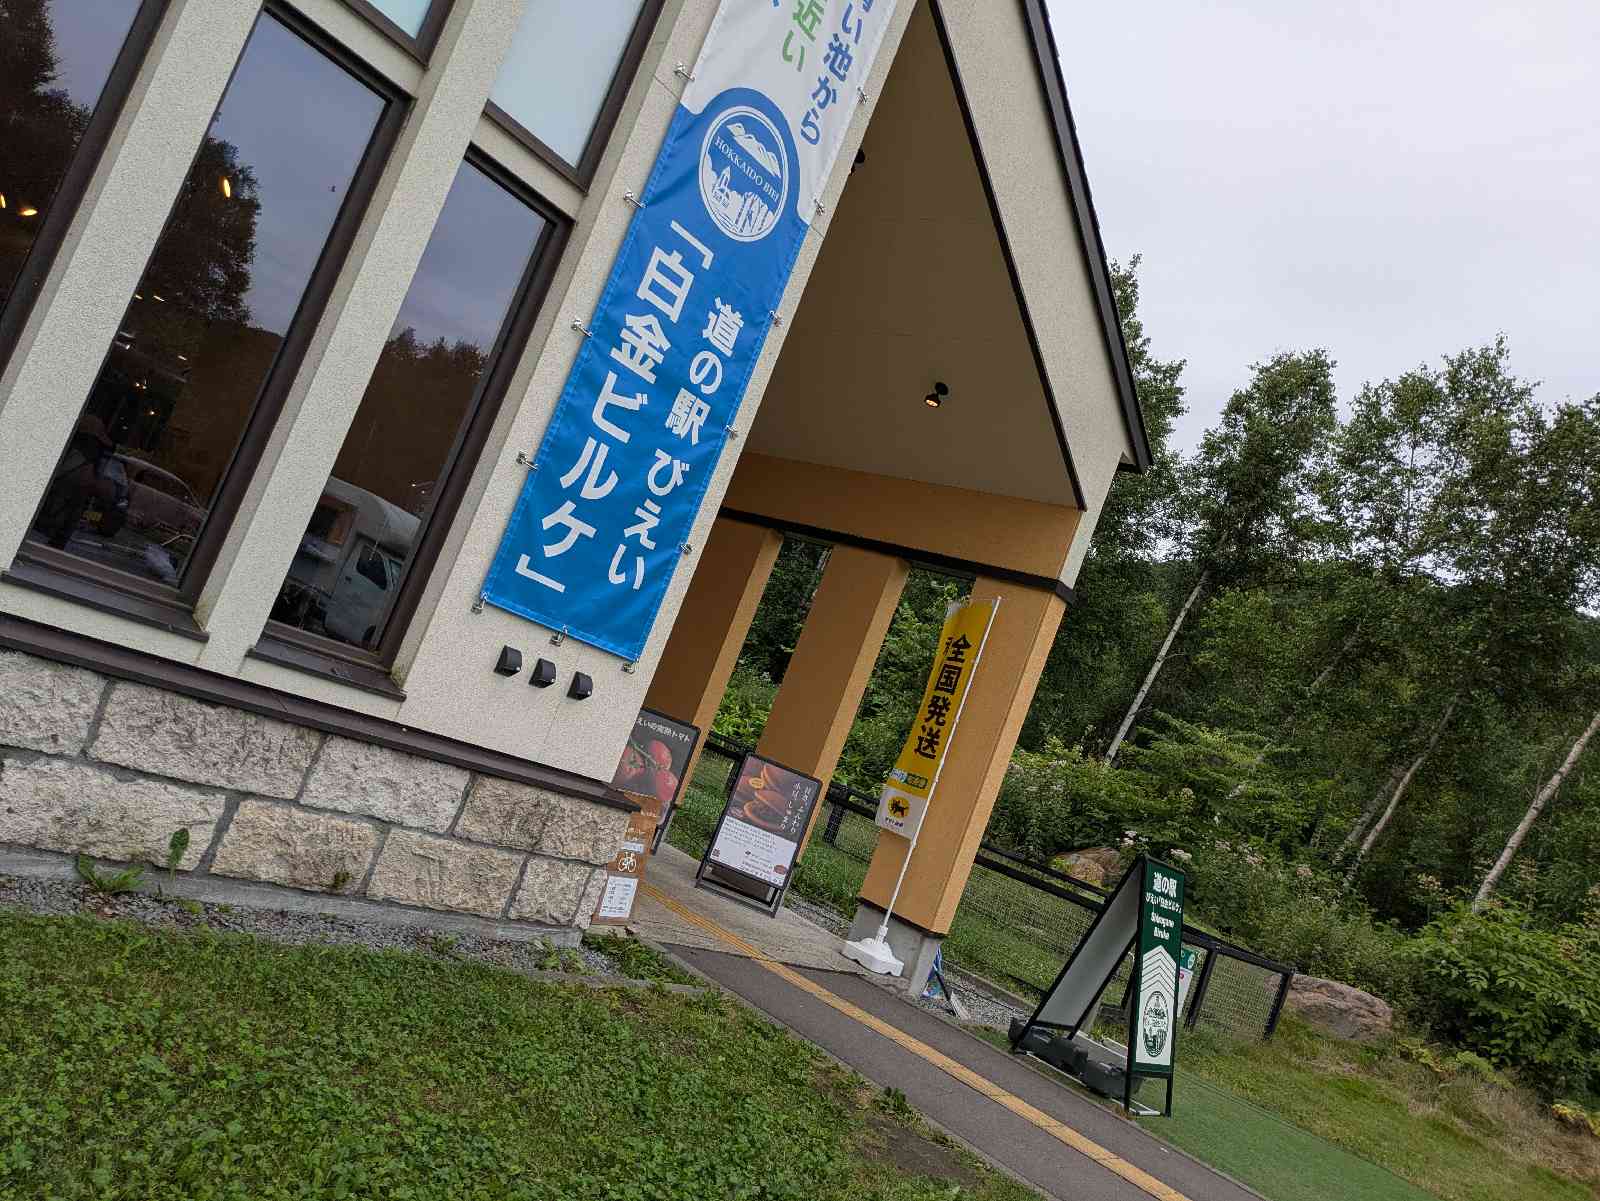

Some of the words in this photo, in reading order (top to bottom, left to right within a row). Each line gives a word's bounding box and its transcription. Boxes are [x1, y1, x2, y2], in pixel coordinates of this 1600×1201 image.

[801, 0, 874, 145] い池から
[715, 136, 763, 185] HOKKAIDO
[762, 182, 780, 201] BIEI
[514, 219, 715, 593] 「白金ビルケ」
[665, 296, 744, 445] 道の駅
[608, 448, 690, 590] びえい
[914, 633, 972, 760] 全国発送
[1153, 871, 1177, 898] 道の駅
